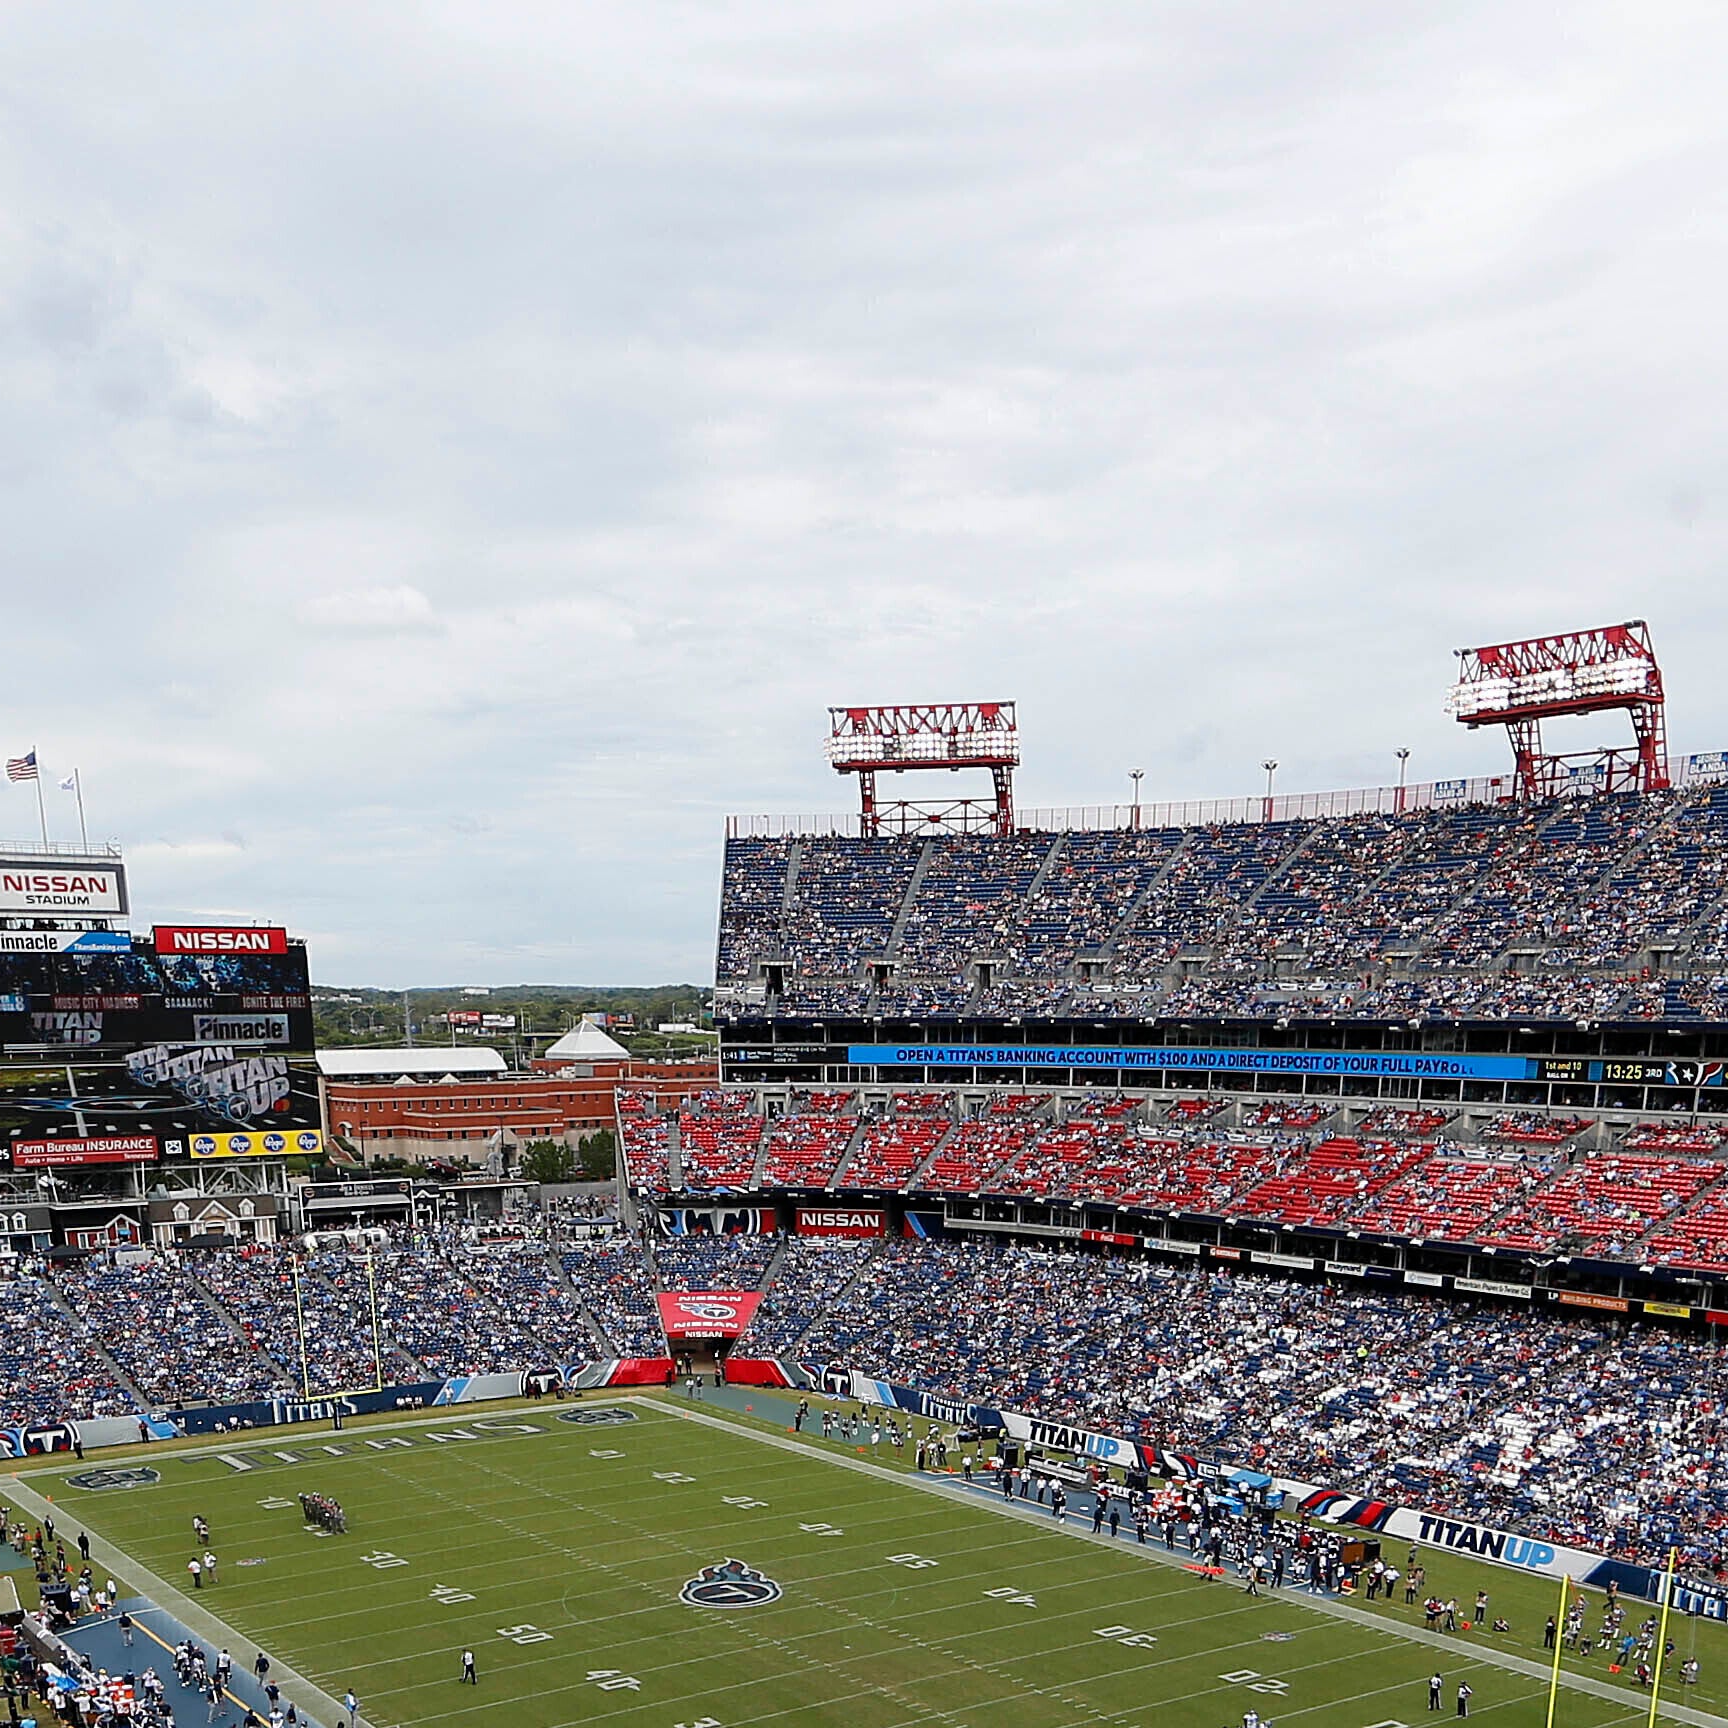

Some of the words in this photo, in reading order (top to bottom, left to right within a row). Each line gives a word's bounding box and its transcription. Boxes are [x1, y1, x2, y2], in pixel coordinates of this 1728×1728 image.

[1690, 761, 1726, 774] BLANDA
[3, 875, 107, 893] NISSAN
[26, 894, 89, 906] STADIUM
[73, 942, 131, 953] TitansBanking.com
[173, 932, 270, 950] NISSAN
[54, 997, 81, 1009] MUSIC
[85, 997, 100, 1009] CITY
[242, 997, 267, 1008] IGNITE
[270, 997, 284, 1008] THE
[31, 1012, 103, 1030] TITAN
[199, 1018, 283, 1040] Pinnacle
[896, 1049, 934, 1061] OPEN
[936, 1049, 945, 1061] A
[947, 1049, 993, 1062] TITANS
[997, 1050, 1054, 1063] BANKING
[1057, 1050, 1122, 1066] ACCOUNT
[1125, 1053, 1156, 1065] WITH
[1159, 1052, 1187, 1066] $100
[1190, 1054, 1215, 1066] AND
[1217, 1054, 1226, 1066] A
[1228, 1054, 1271, 1067] DIRECT
[1272, 1056, 1321, 1069] DEPOSIT
[1324, 1057, 1341, 1070] OF
[1343, 1057, 1378, 1071] YOUR
[1381, 1058, 1412, 1072] FULL
[1415, 1059, 1474, 1074] PAYROLL
[203, 1056, 289, 1097] TITAN
[1605, 1064, 1642, 1080] 13:25
[17, 1143, 45, 1154] Farm
[47, 1141, 84, 1153] Bureau
[86, 1138, 153, 1151] INSURANCE
[802, 1213, 879, 1227] NISSAN
[1548, 1292, 1558, 1300] LP
[272, 1397, 358, 1424] TITANS
[920, 1392, 978, 1424] TITANS
[182, 1417, 548, 1475] TITANS
[496, 1624, 554, 1645] 50
[585, 1670, 641, 1691] 40
